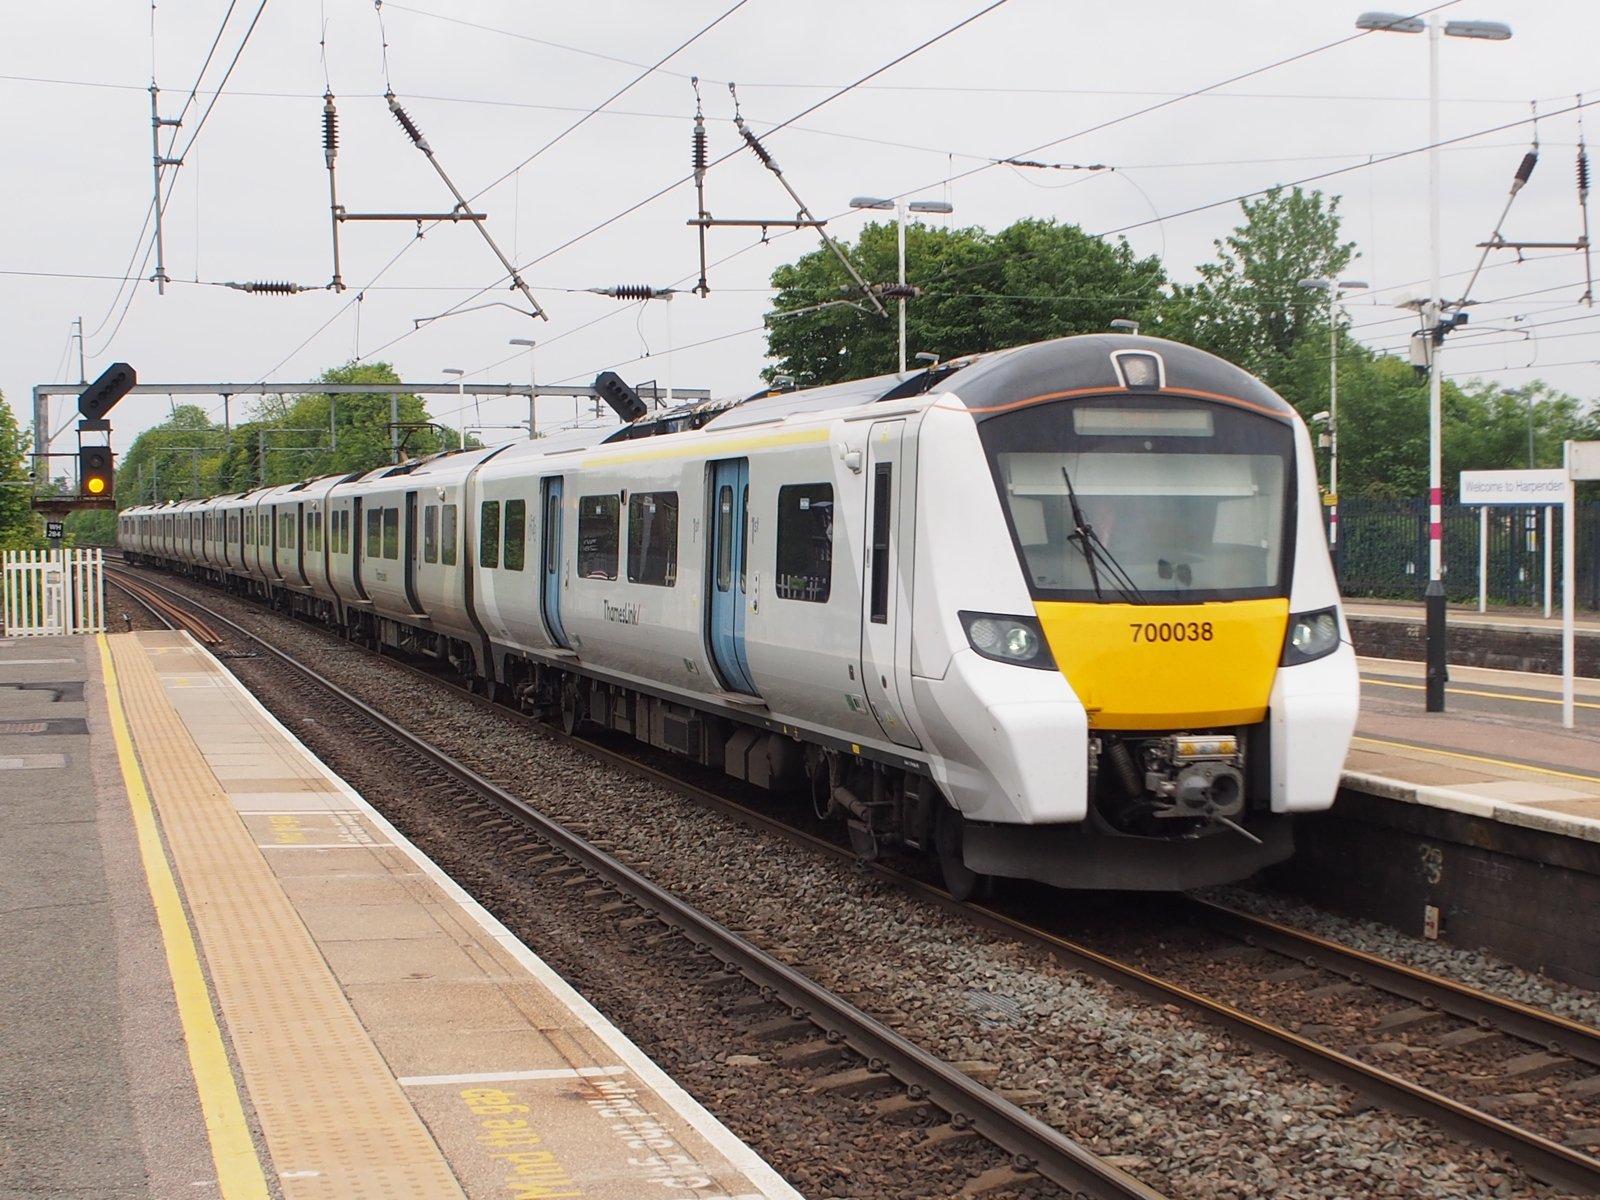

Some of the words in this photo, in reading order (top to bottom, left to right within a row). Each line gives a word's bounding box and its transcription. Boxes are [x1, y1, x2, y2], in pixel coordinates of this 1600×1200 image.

[1466, 481, 1504, 493] Welcome
[1505, 481, 1514, 493] to
[1516, 480, 1564, 494] Harpenden
[1129, 621, 1214, 642] 700038
[459, 1087, 530, 1115] gap
[474, 1119, 542, 1147] the
